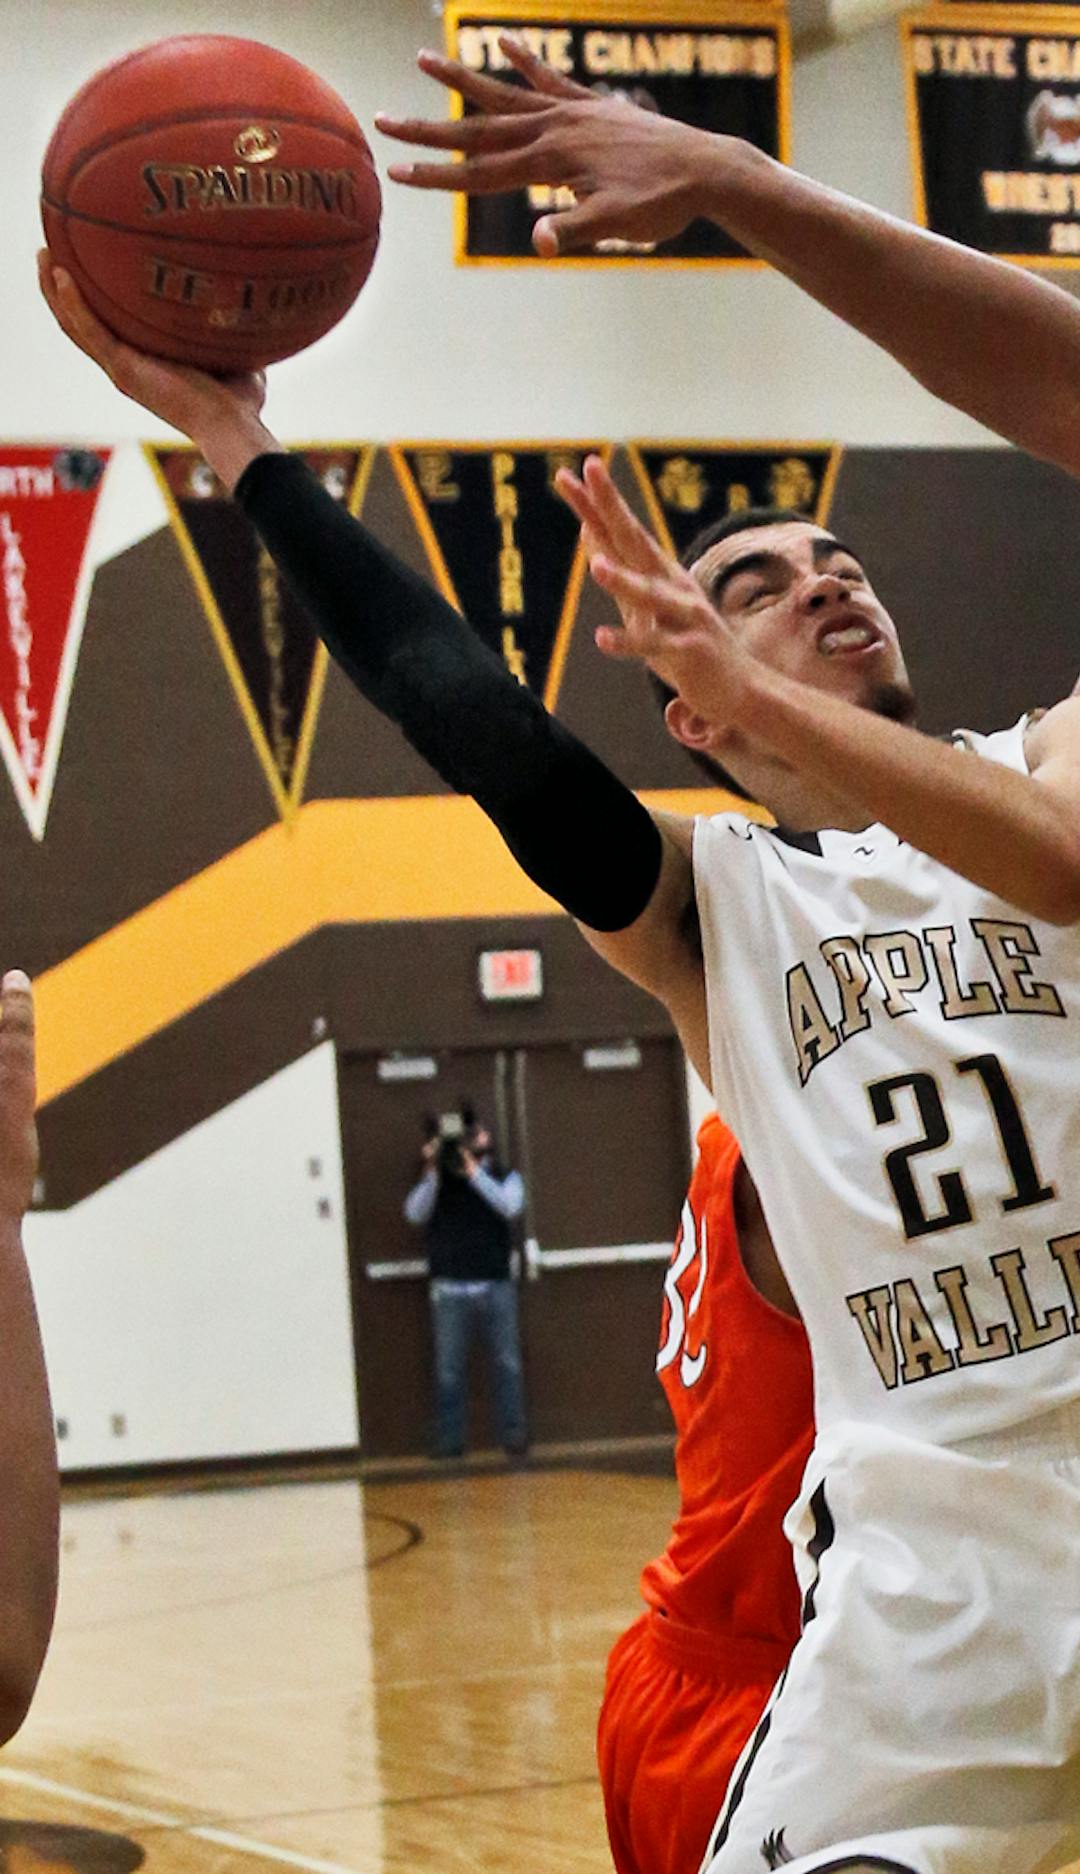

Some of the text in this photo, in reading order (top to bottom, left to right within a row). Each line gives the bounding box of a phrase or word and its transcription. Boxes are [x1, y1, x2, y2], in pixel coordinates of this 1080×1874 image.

[913, 34, 1017, 78] STATE
[142, 162, 360, 218] SPALDING
[785, 917, 1067, 1087] APPLE
[864, 1052, 1057, 1241] 21
